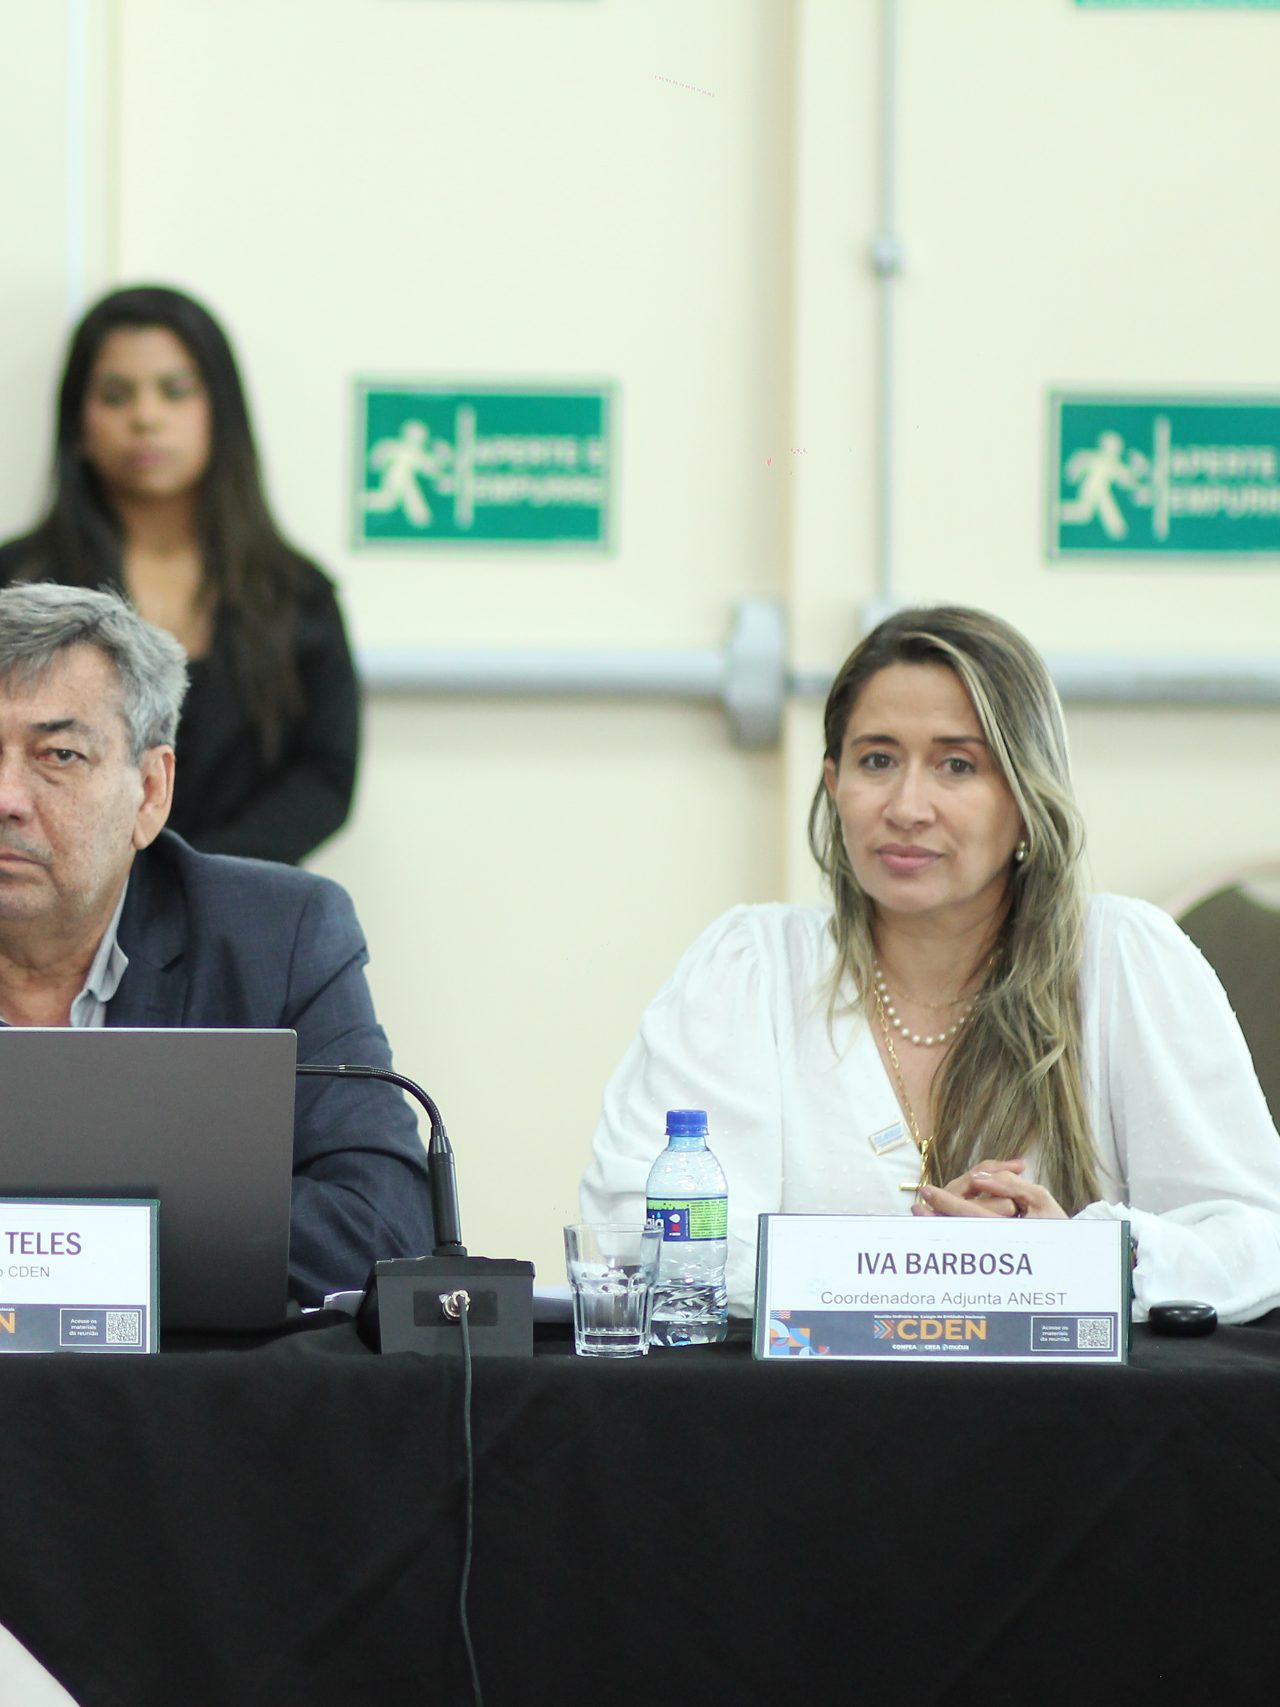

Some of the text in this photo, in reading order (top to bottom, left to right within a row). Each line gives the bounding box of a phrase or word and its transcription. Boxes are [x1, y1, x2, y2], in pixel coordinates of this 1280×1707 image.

[5, 1231, 82, 1256] TELES
[8, 1266, 50, 1278] CDEN
[857, 1252, 1033, 1276] IVA BARBOSA
[820, 1291, 1068, 1308] Coordenadora Adjunta ANEST
[897, 1319, 987, 1340] CDEN
